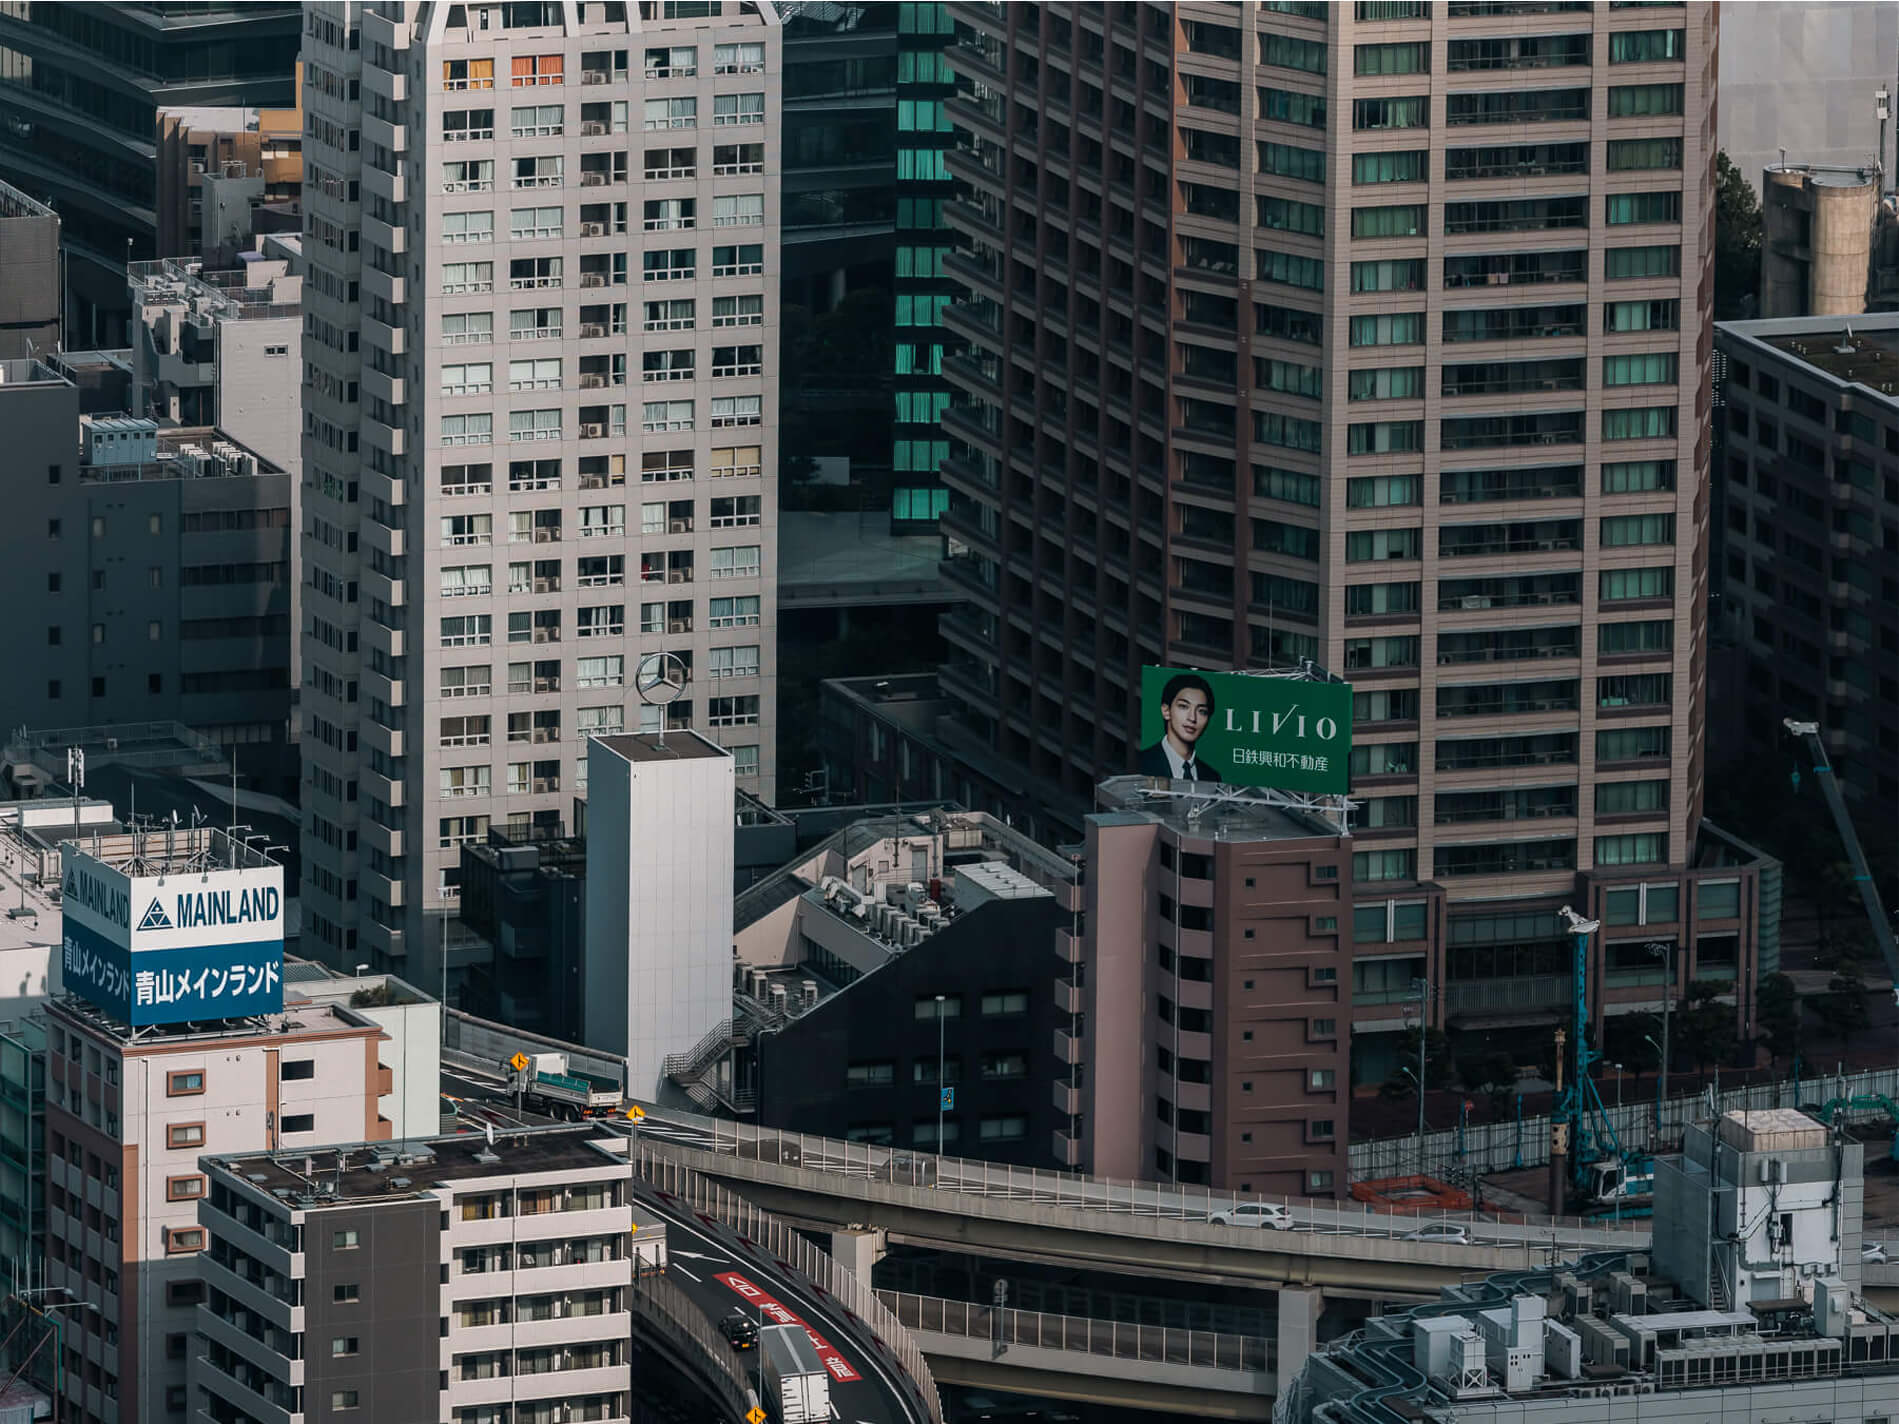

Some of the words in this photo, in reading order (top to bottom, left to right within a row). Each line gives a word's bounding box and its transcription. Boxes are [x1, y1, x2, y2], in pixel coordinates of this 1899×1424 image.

[1225, 704, 1337, 740] LIVIO
[1232, 747, 1329, 772] 日鉄興和不動産
[80, 869, 129, 929] MAINLAND
[177, 886, 279, 929] MAINLAND
[136, 960, 280, 1007] 青山メインランド
